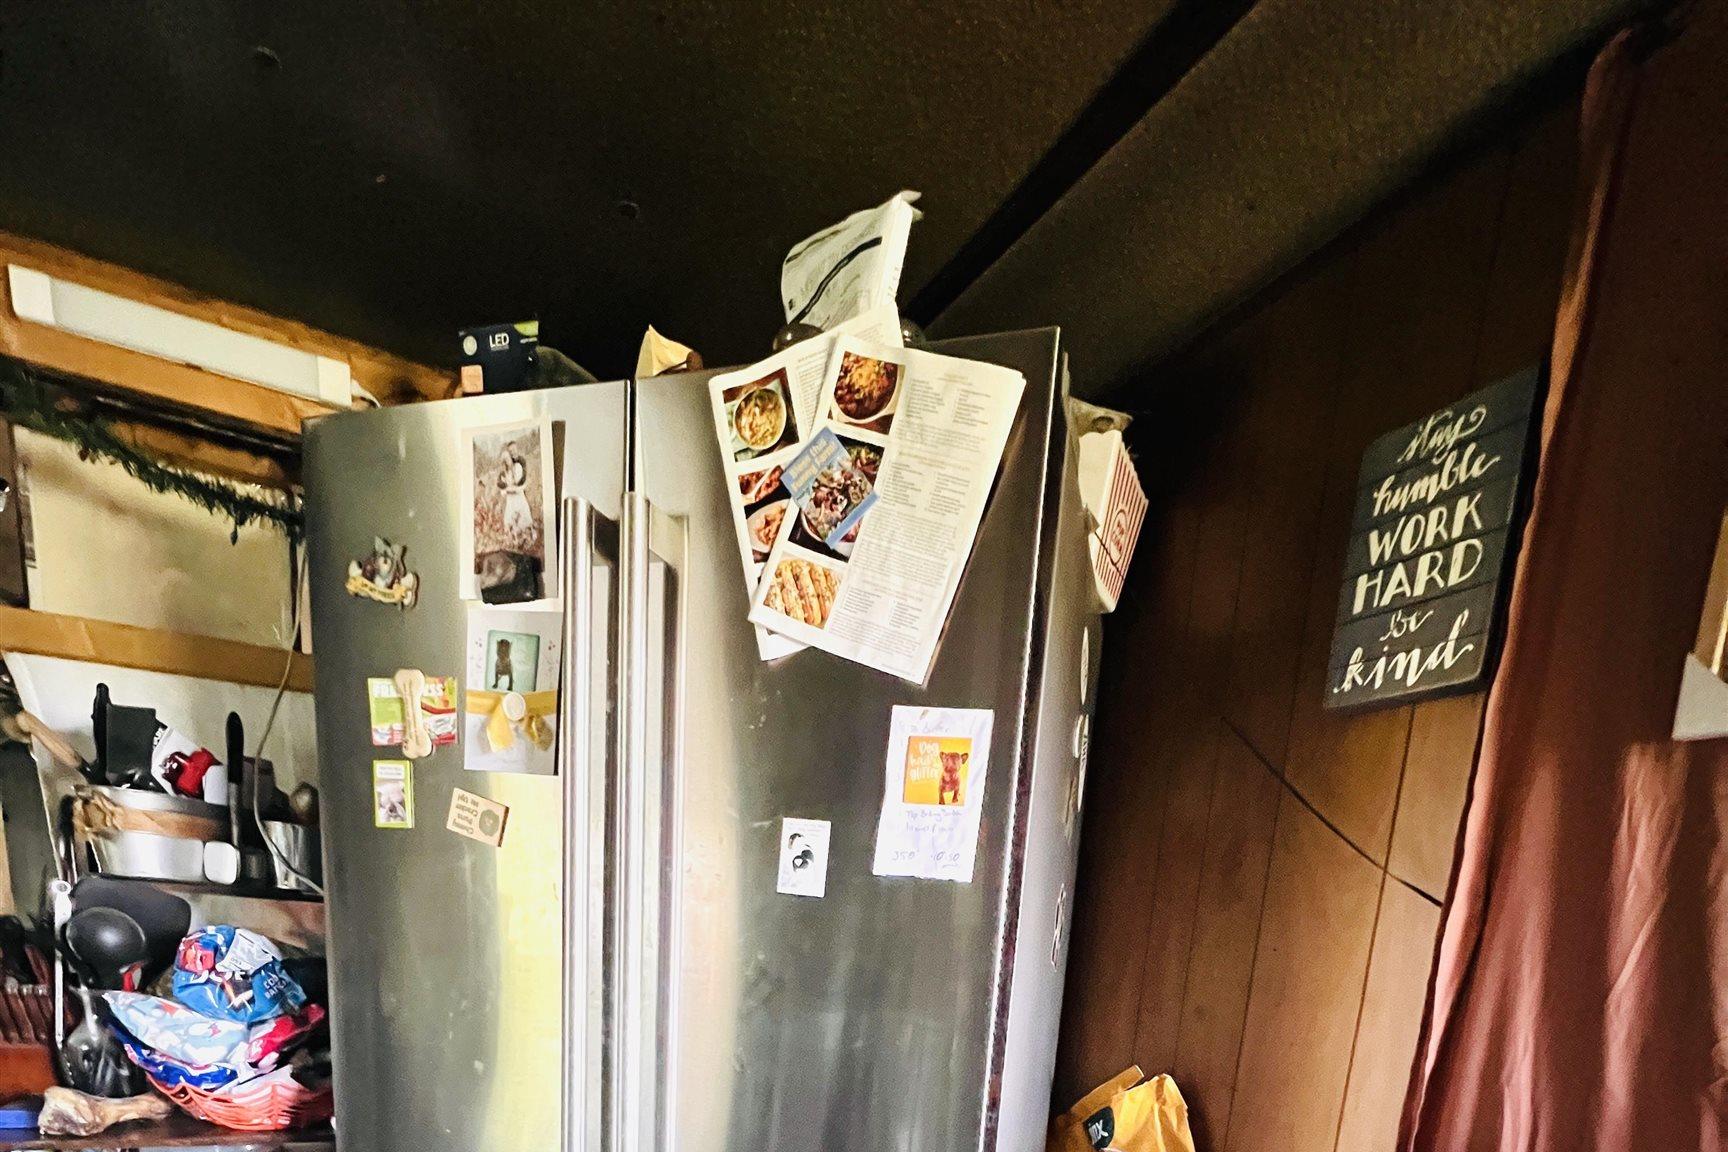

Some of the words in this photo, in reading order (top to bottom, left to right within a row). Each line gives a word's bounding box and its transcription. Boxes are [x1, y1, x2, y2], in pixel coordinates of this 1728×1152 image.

[489, 332, 510, 348] LED
[1397, 404, 1487, 464] stay
[1373, 442, 1500, 517] humble
[1368, 492, 1483, 566] WORK
[1352, 538, 1484, 615] HARD
[1333, 608, 1475, 693] kind
[1379, 610, 1434, 642] be
